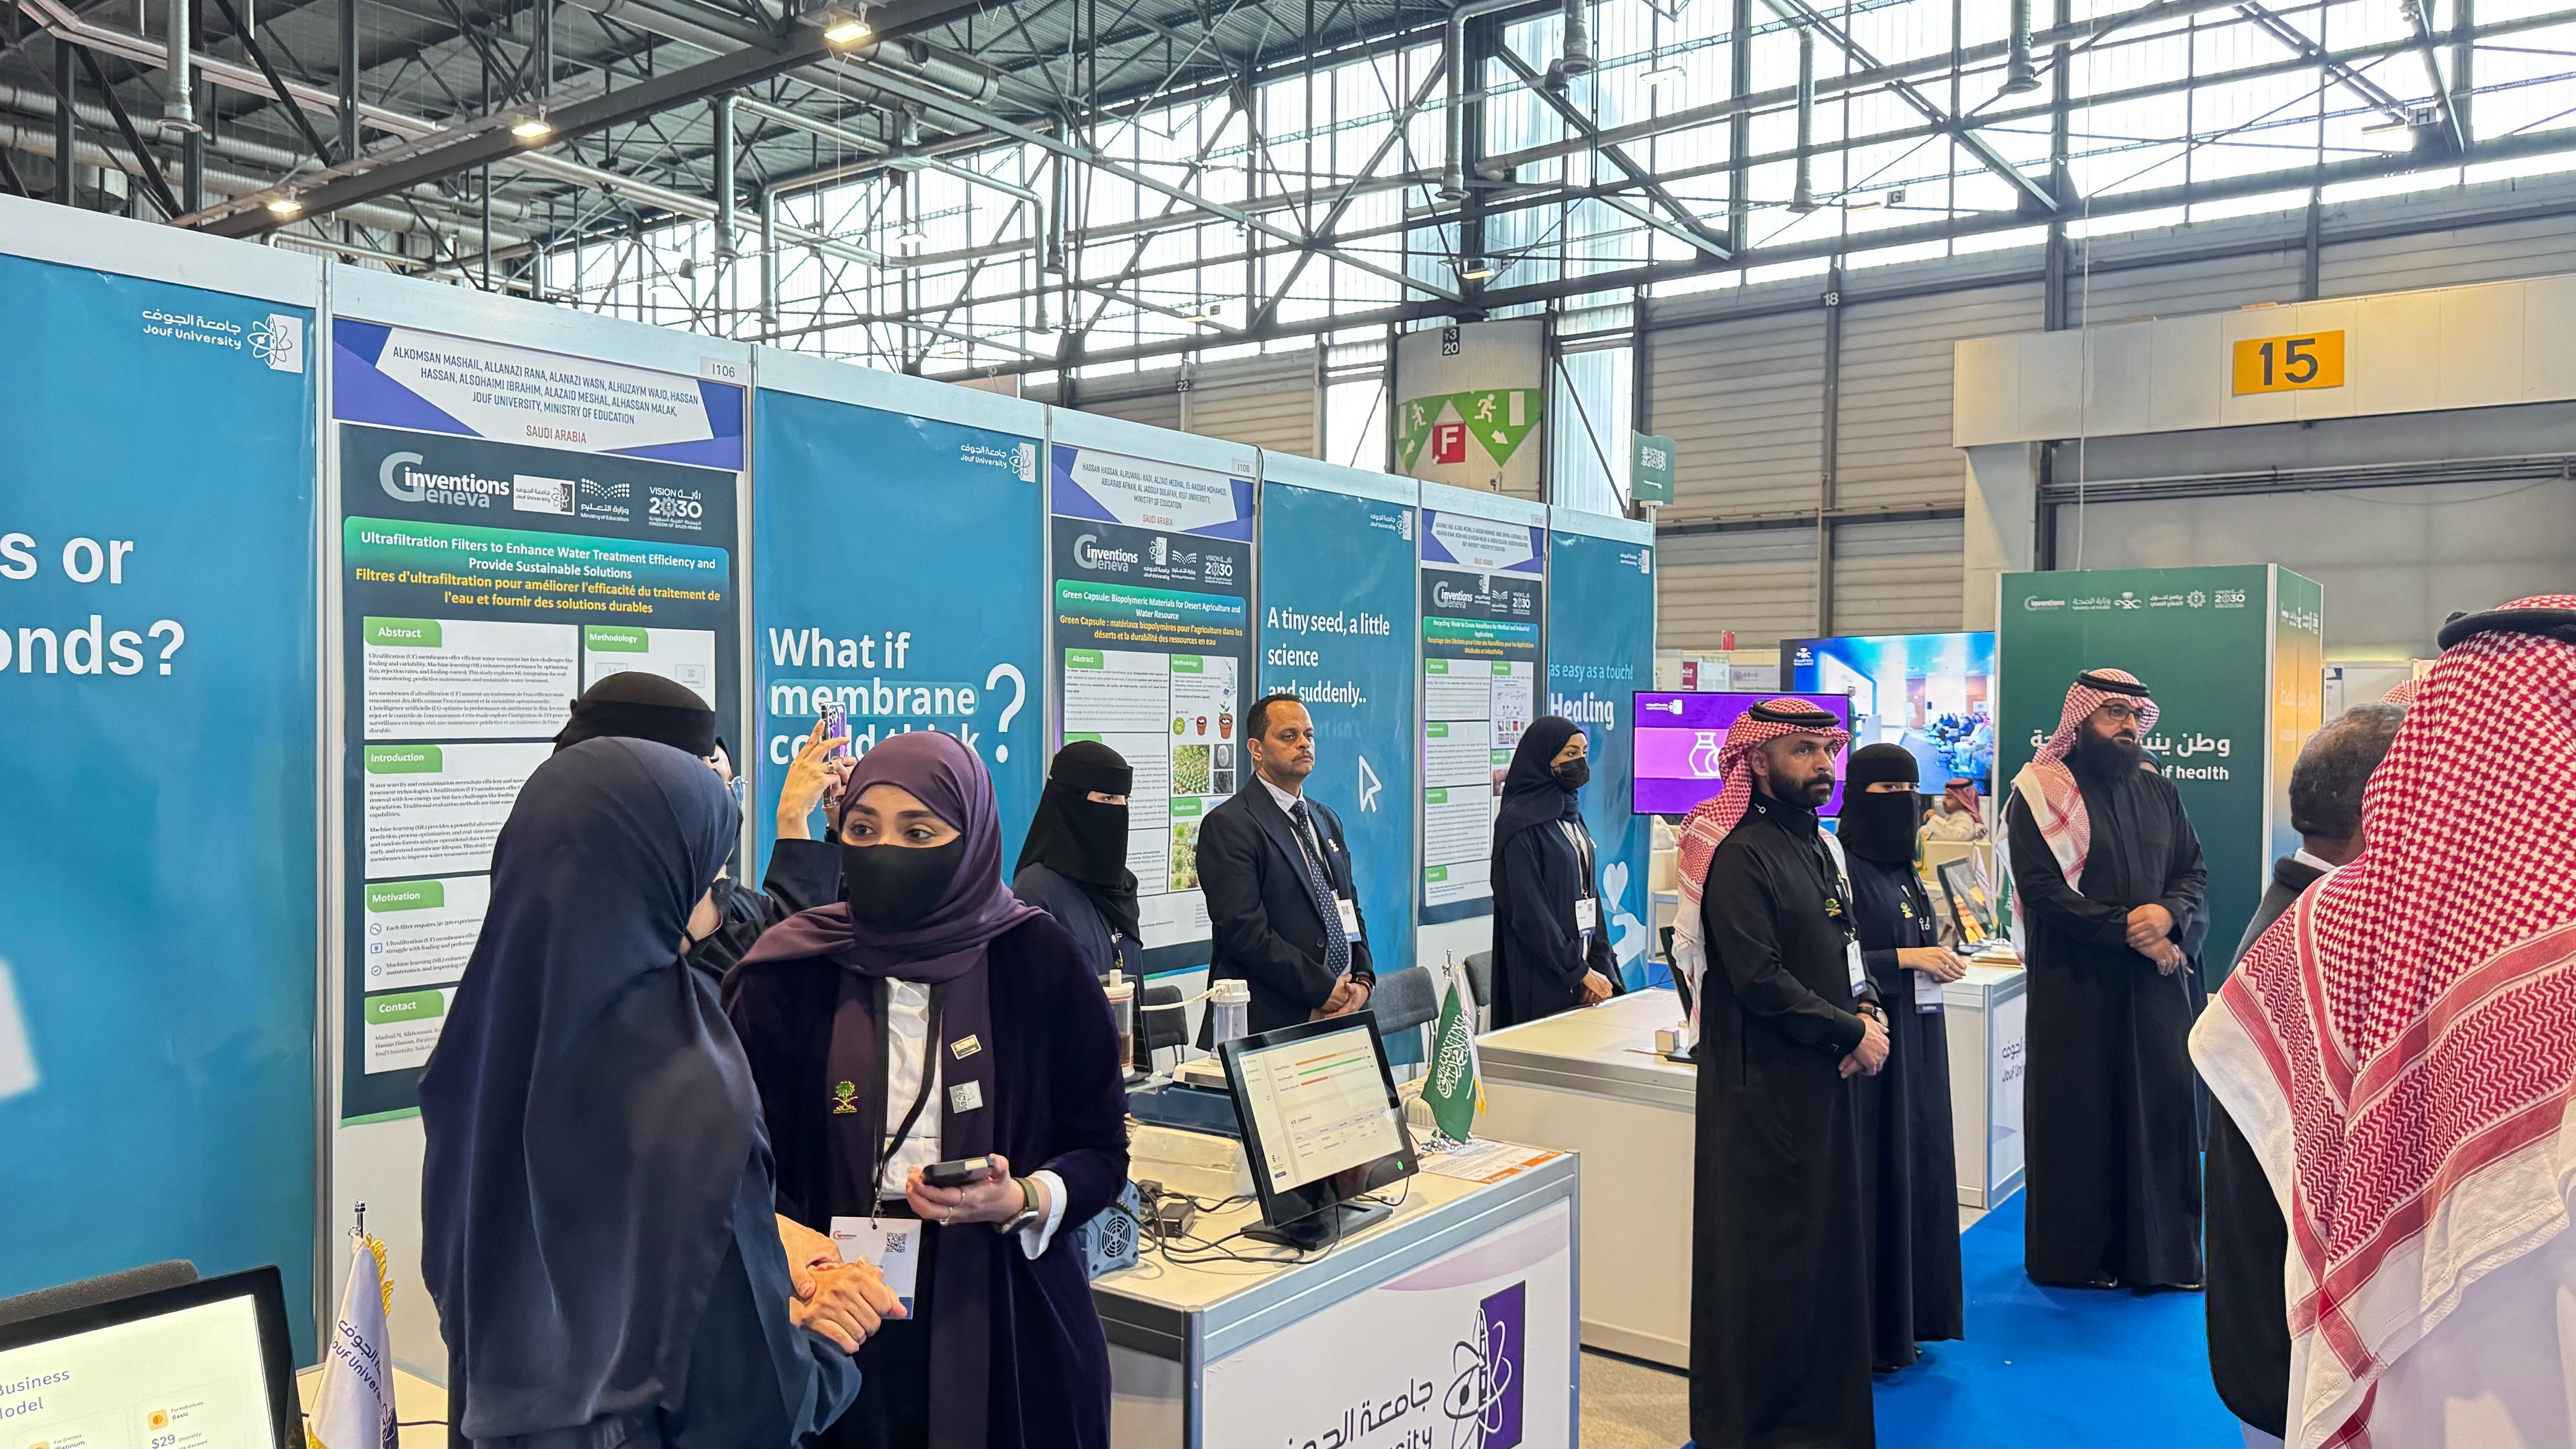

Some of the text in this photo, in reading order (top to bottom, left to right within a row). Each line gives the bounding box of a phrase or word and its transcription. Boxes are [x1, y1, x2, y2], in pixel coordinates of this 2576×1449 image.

[2416, 108, 2430, 124] H
[1823, 292, 1839, 307] 18
[142, 308, 242, 335] جامعة الجوف
[143, 323, 242, 350] Jouf University
[1444, 342, 1458, 355] 20
[2258, 337, 2319, 386] 15
[393, 346, 698, 404] ALKOMSAN MASHAIL, ALLANAZI RANA, ALANAZI WASN, ALHUZAYM WAJD, HASSAN
[421, 367, 677, 417] HASSAN, ALSOHAIMI IBRAHIM, ALAZAID MESHAL, ALHASSAN MALAK,
[1177, 381, 1190, 392] 22
[472, 391, 634, 424] JOUF UNIVERSITY, MINISTRY OF EDUCATION
[526, 425, 586, 443] SAUDI ARABIA
[1442, 426, 1459, 455] F
[960, 442, 1007, 459] جامعة الجوف
[960, 454, 1007, 469] Jouf University
[404, 466, 510, 496] inventions
[649, 487, 676, 497] VISION
[0, 533, 134, 584] s or
[361, 531, 715, 569] Ultrafiltration Filters to Enhance Water Treatment Efficiency and
[1087, 545, 1139, 564] inventions
[469, 557, 632, 579] Provide Sustainable Solutions
[356, 568, 720, 600] Filtres d'ultrafiltration pour améliorer l'efficacité du traitement de
[445, 591, 653, 613] l'eau et fournir des solutions durables
[1063, 590, 1082, 599] Green
[1084, 591, 1110, 601] Capsule:
[1112, 594, 1147, 605] Biopolymeric
[1149, 598, 1175, 607] Materials
[1175, 600, 1183, 608] for
[1184, 601, 1201, 609] Desert
[1202, 603, 1230, 612] Agriculture
[1441, 588, 1473, 603] inventions
[1060, 615, 1079, 624] Green
[1080, 617, 1105, 627] Capsule
[1110, 619, 1138, 629] matériaux
[1139, 621, 1176, 632] biopolymères
[1191, 625, 1222, 635] l'agriculture
[1222, 627, 1234, 635] dans
[1136, 609, 1178, 619] Water Resource
[1268, 607, 1390, 636] A tiny seed, a little
[378, 627, 422, 638] Abstract
[590, 633, 637, 644] Methodology
[1094, 630, 1116, 639] déserts
[1124, 632, 1129, 640] la
[1130, 632, 1157, 642] durabilité
[1159, 634, 1168, 643] des
[769, 627, 911, 669] What if
[1268, 643, 1319, 667] science
[1073, 655, 1094, 664] Abstract
[1550, 664, 1634, 682] as easy as a touch!
[770, 677, 975, 715] membrane
[1299, 680, 1367, 708] suddenly..
[1550, 691, 1614, 731] Healing
[770, 724, 876, 765] cold
[2177, 733, 2230, 757] وطن
[371, 753, 425, 763] Introduction
[2175, 765, 2229, 780] health
[372, 891, 420, 903] Motivation
[379, 1000, 417, 1014] Contact
[331, 1336, 352, 1359] ouf
[0, 1396, 44, 1419] odel
[1360, 1378, 1433, 1437] جامعة
[152, 1434, 176, 1449] $29
